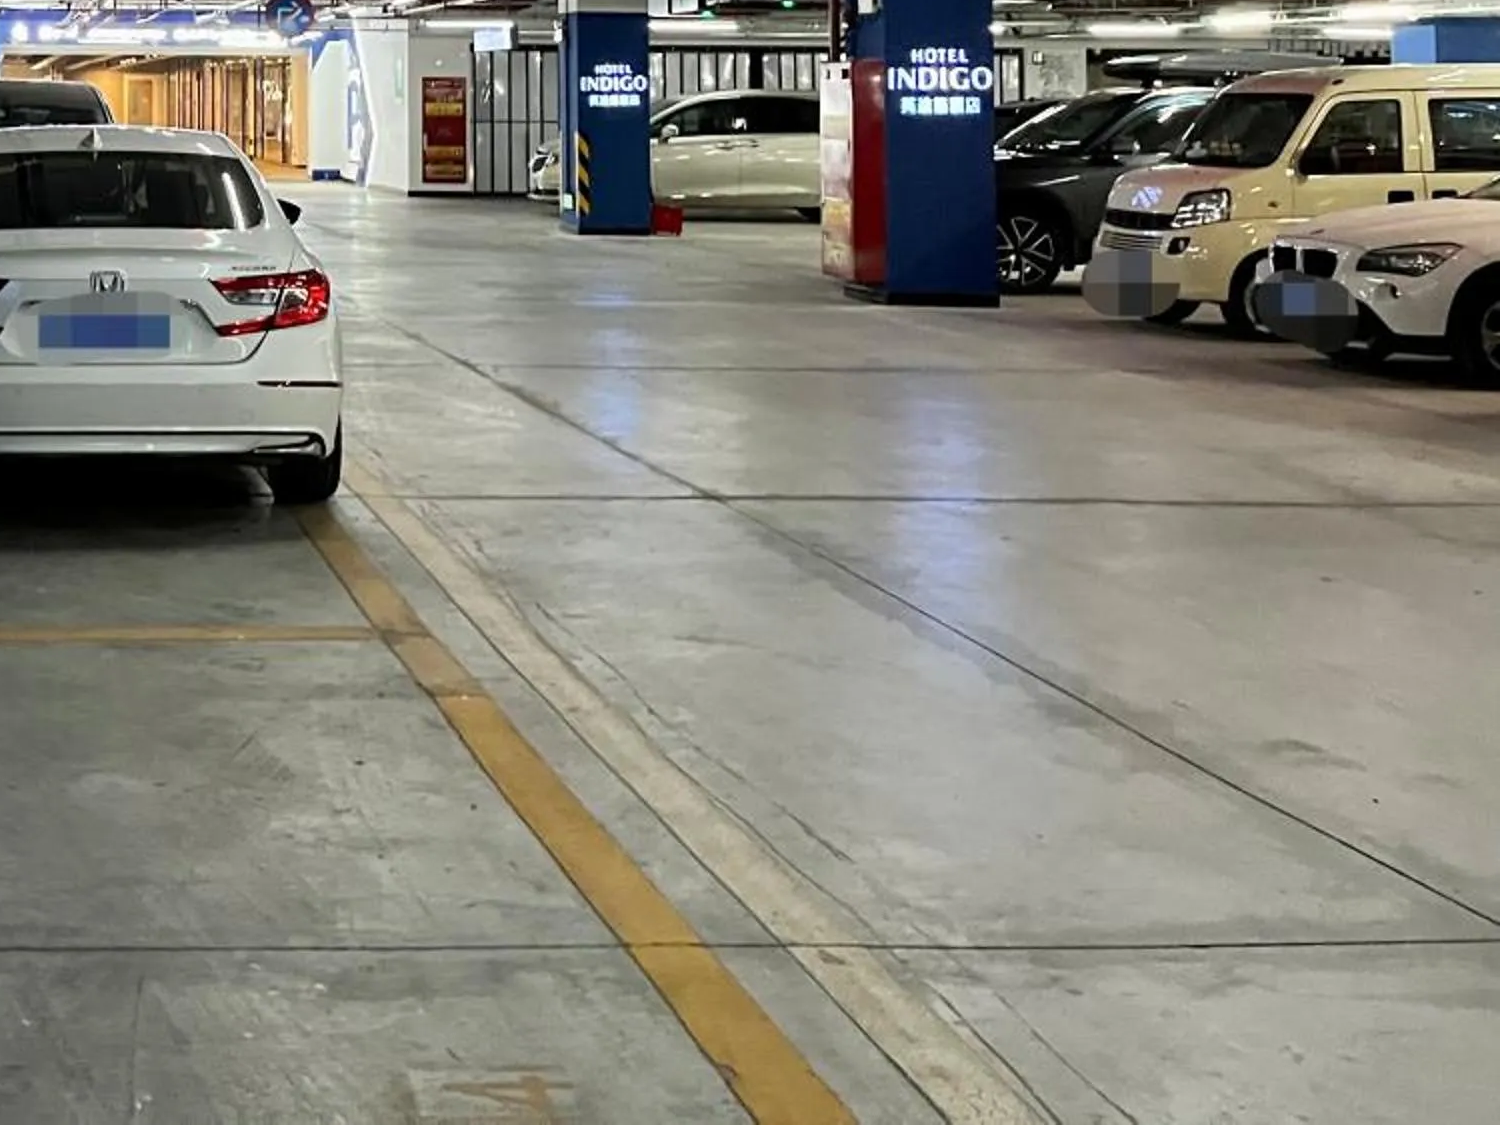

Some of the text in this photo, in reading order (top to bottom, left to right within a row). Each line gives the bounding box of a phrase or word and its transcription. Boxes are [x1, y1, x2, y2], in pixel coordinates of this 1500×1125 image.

[910, 48, 969, 64] HOTEL
[594, 63, 633, 75] HOTEL
[580, 75, 648, 92] INDIGO
[887, 66, 993, 92] INDIGO
